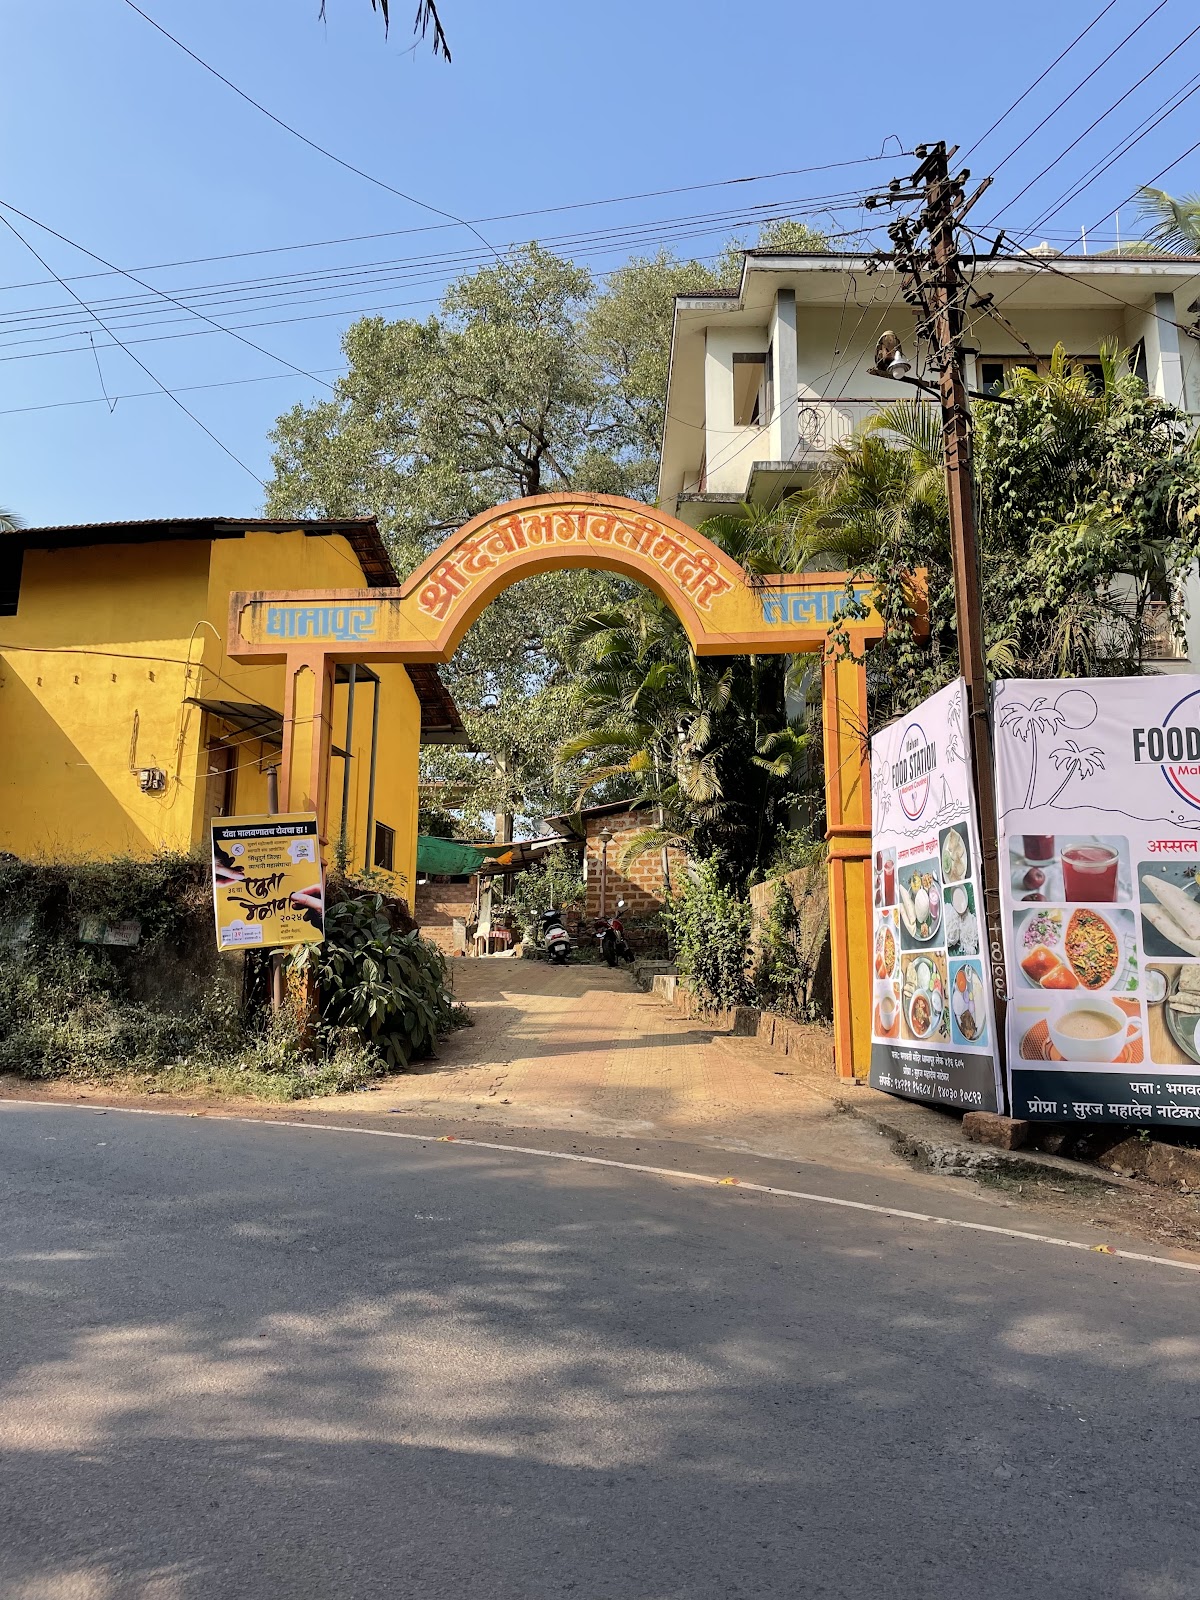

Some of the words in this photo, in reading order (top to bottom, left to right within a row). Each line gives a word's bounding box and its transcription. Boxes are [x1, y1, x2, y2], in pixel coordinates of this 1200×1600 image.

[266, 605, 379, 642] धामापूर
[1132, 727, 1200, 762] FOOD
[892, 758, 908, 789] FOOD
[909, 741, 937, 780] STATION
[1146, 840, 1198, 853] अस्सल
[280, 914, 302, 922] २०२४
[1072, 1102, 1103, 1119] सुरज
[1107, 1099, 1152, 1119] महादेव
